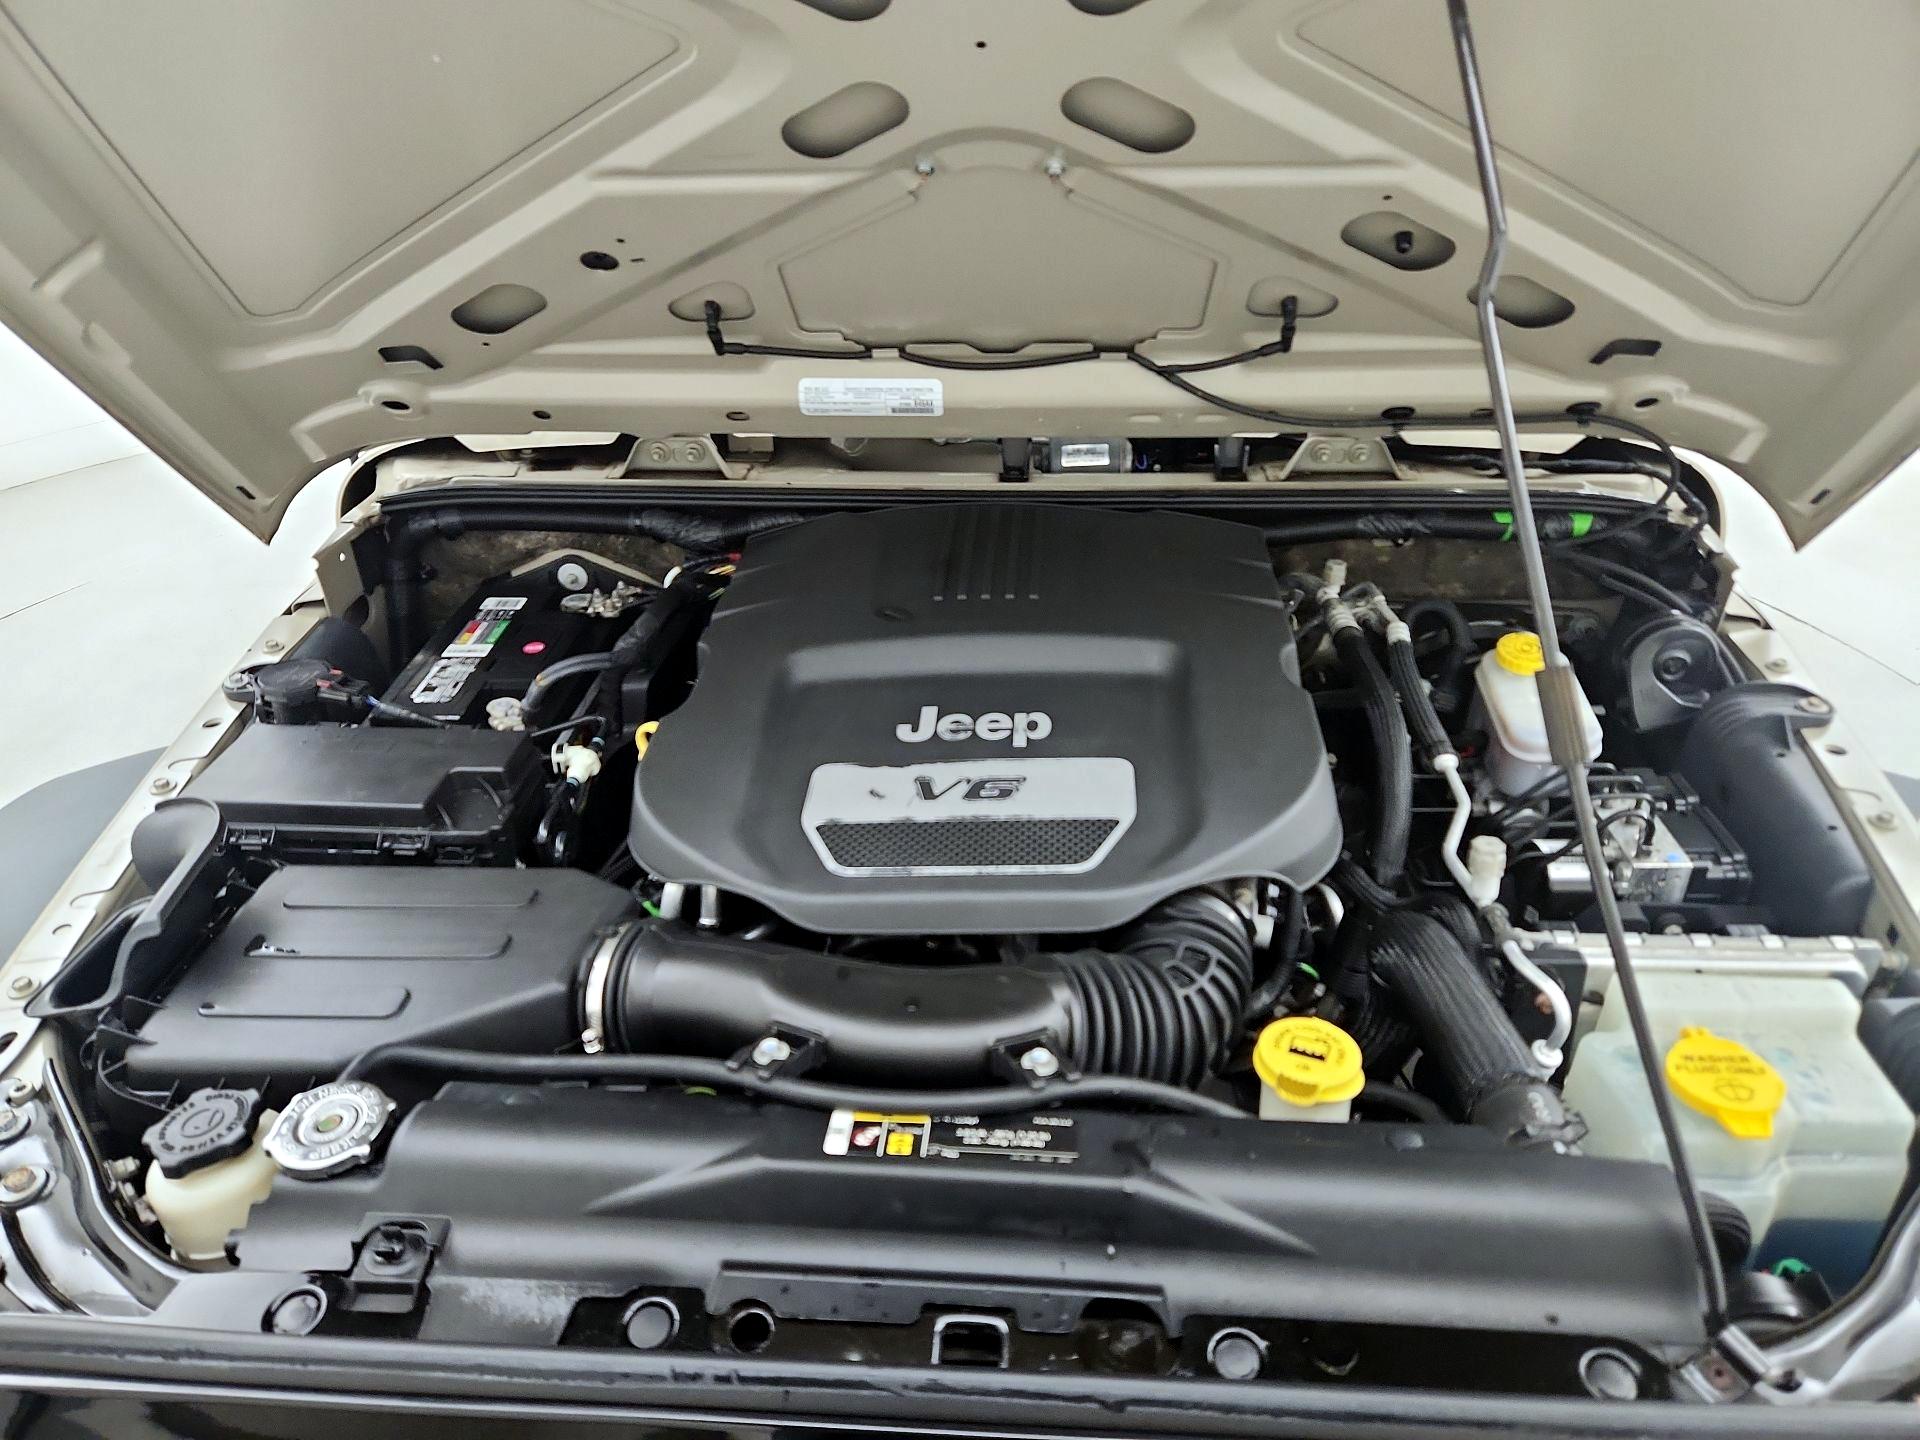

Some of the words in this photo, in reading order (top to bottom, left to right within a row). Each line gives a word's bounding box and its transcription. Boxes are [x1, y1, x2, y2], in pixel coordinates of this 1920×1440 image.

[895, 705, 1053, 748] Jeep
[914, 775, 1027, 801] V6
[1680, 1054, 1750, 1063] WASHER
[1674, 1063, 1721, 1073] FLUID
[1725, 1064, 1766, 1075] ONLY
